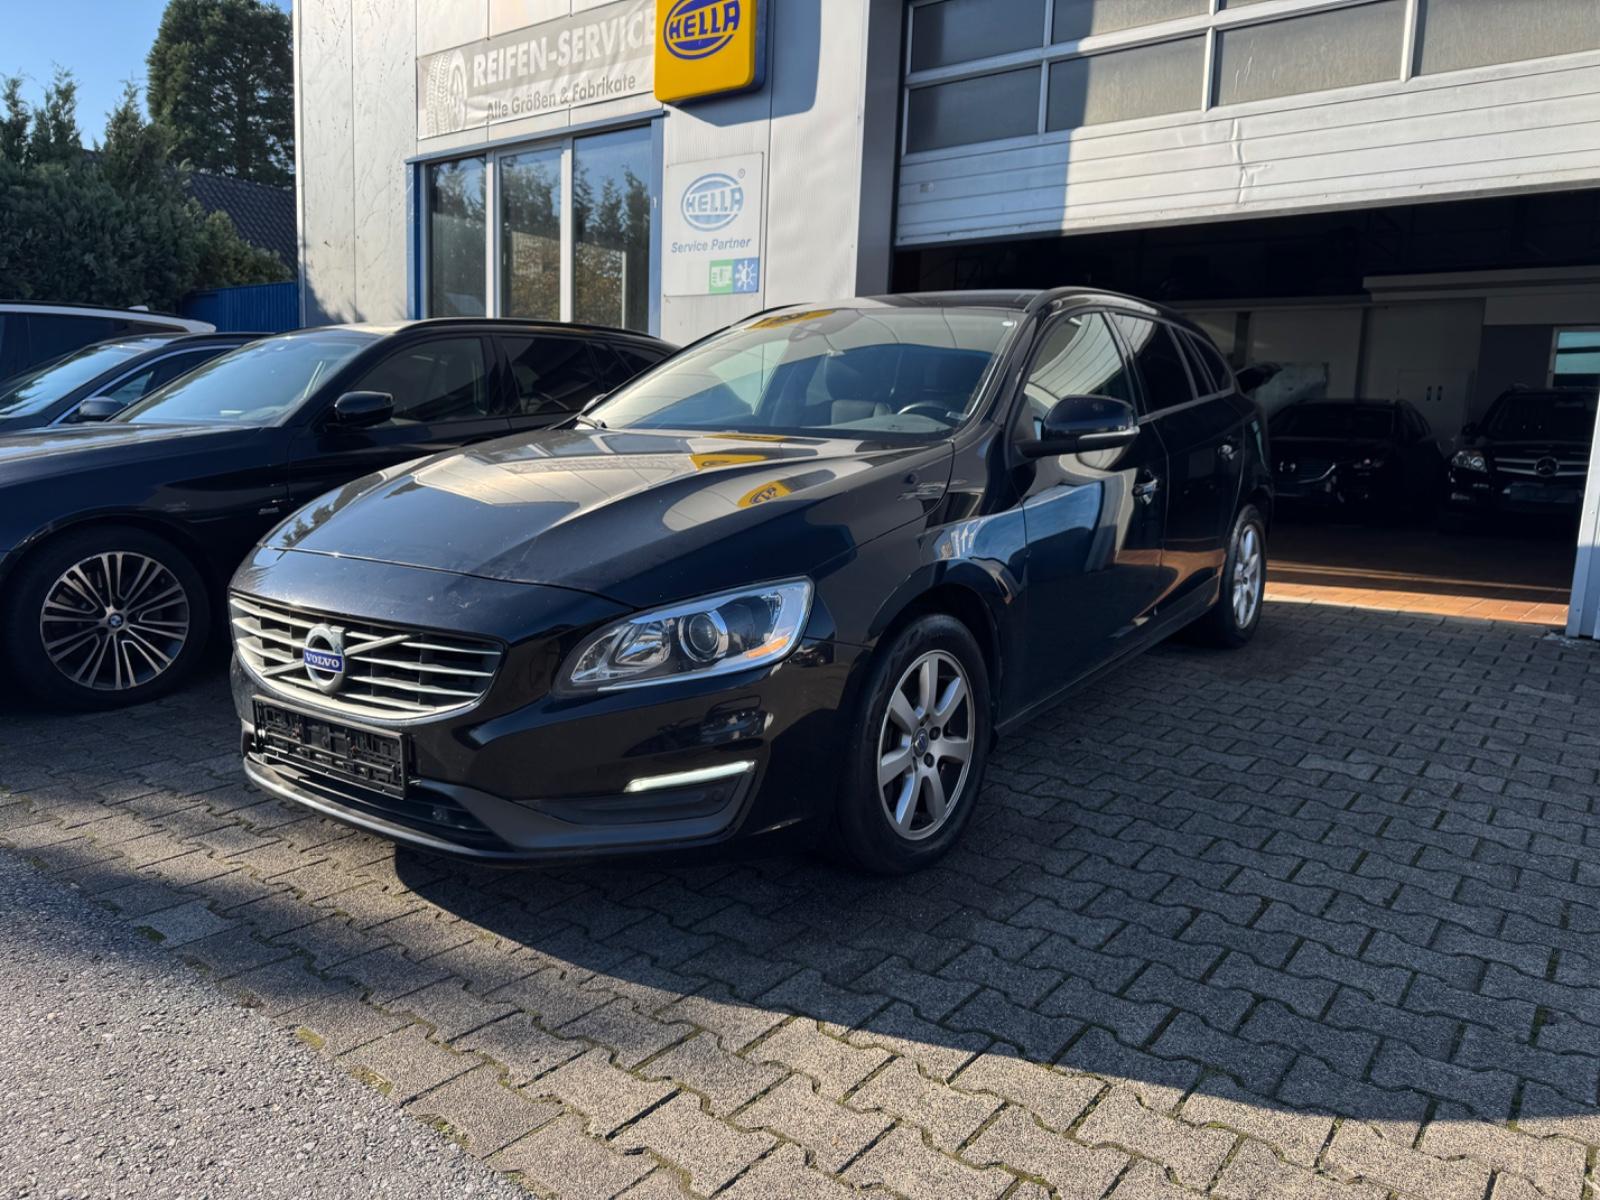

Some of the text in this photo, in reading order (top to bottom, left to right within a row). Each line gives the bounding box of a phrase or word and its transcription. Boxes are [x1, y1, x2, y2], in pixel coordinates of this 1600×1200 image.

[669, 0, 741, 39] HELLA
[473, 9, 655, 88] REIFEN-SERVICE
[511, 91, 556, 115] Größen
[560, 87, 569, 104] &
[572, 74, 636, 99] Fabrikate
[686, 186, 744, 213] HELLA
[671, 238, 751, 253] Service Partner
[305, 652, 340, 668] VOLVO
